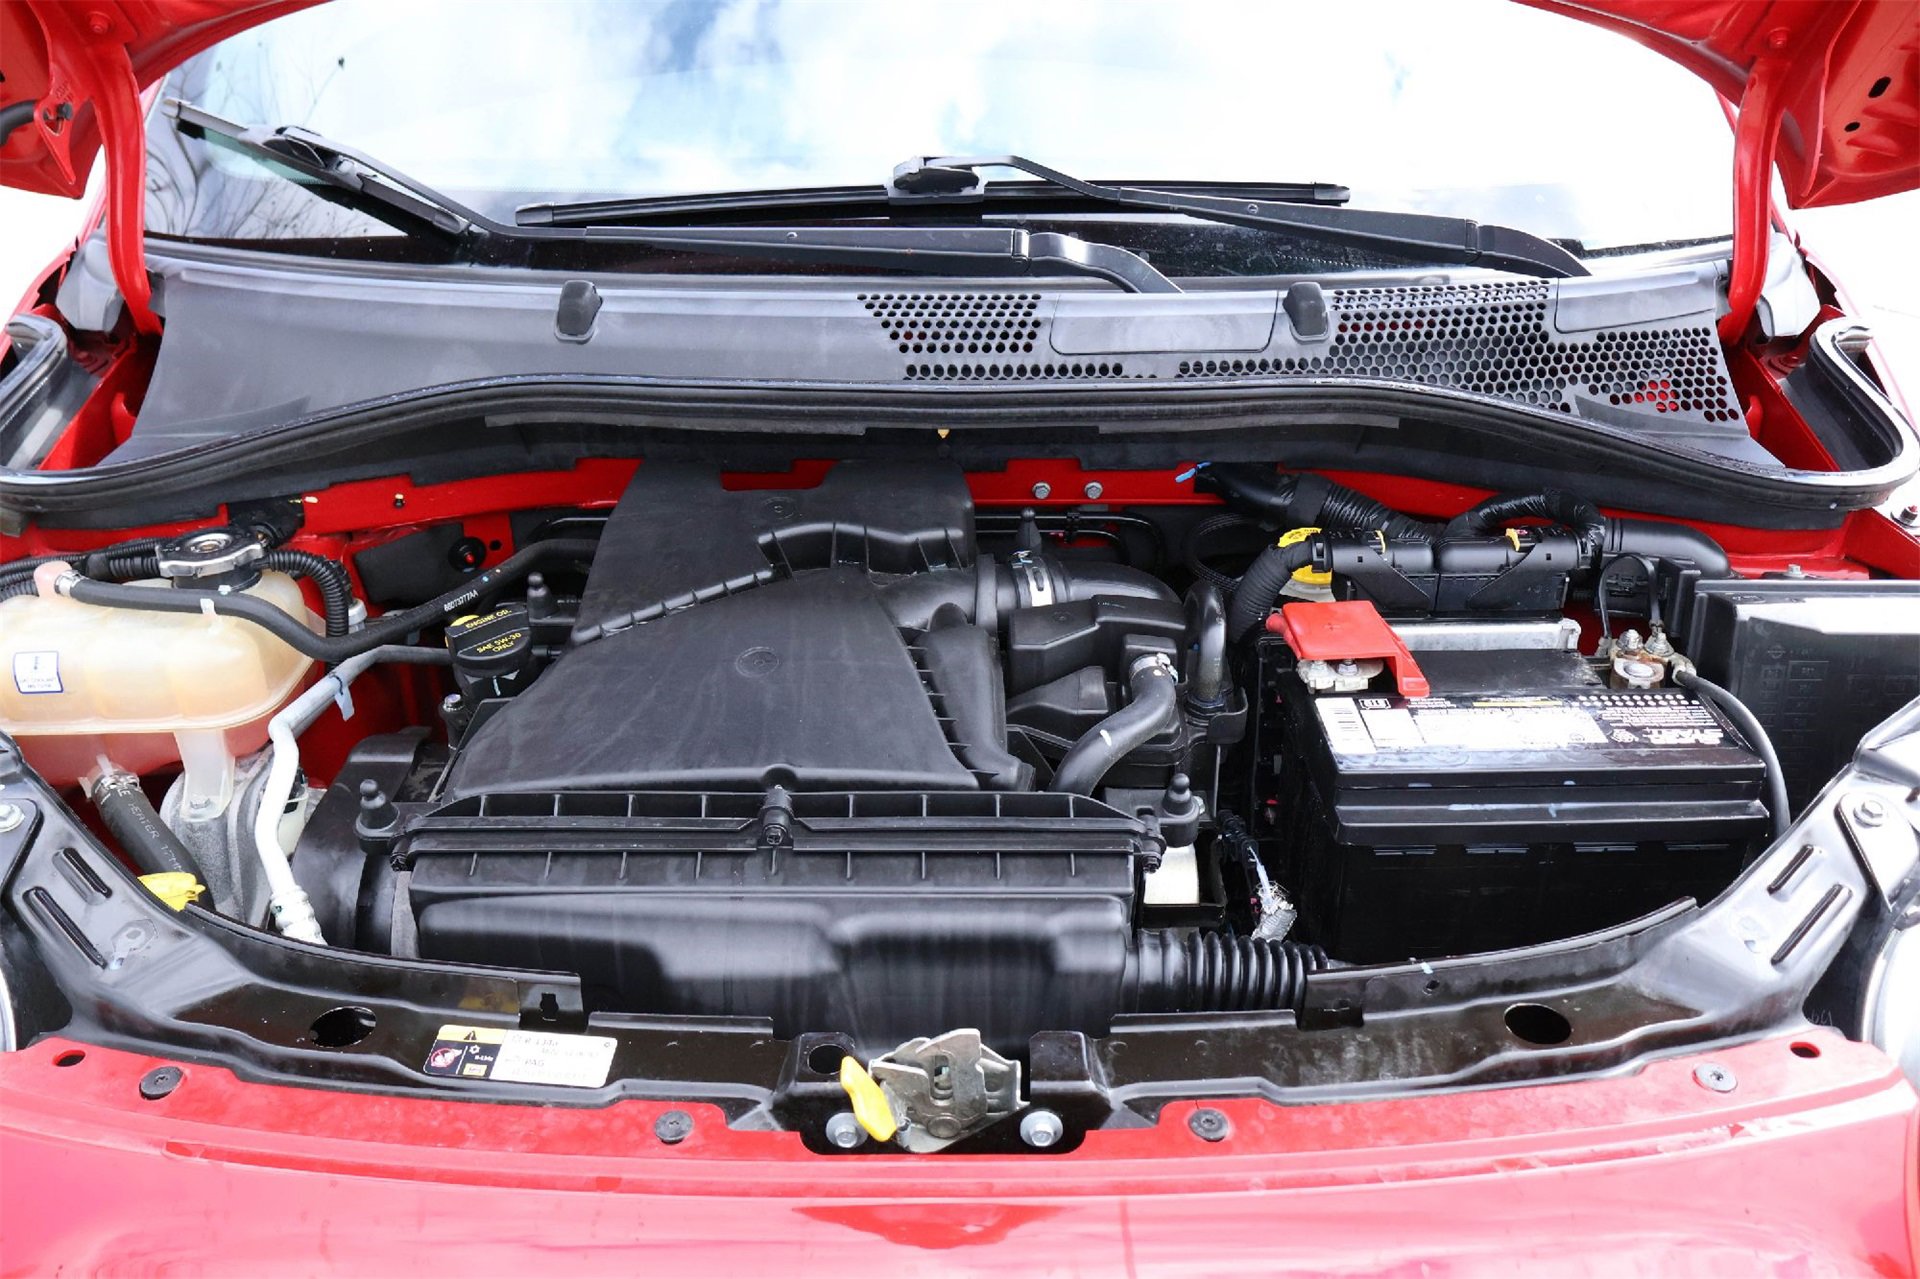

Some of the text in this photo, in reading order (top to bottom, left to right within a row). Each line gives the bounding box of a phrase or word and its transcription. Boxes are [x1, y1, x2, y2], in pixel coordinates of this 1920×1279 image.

[465, 614, 496, 629] ENGINE
[476, 632, 522, 653] SAE 5W-30
[492, 641, 514, 652] ONLY
